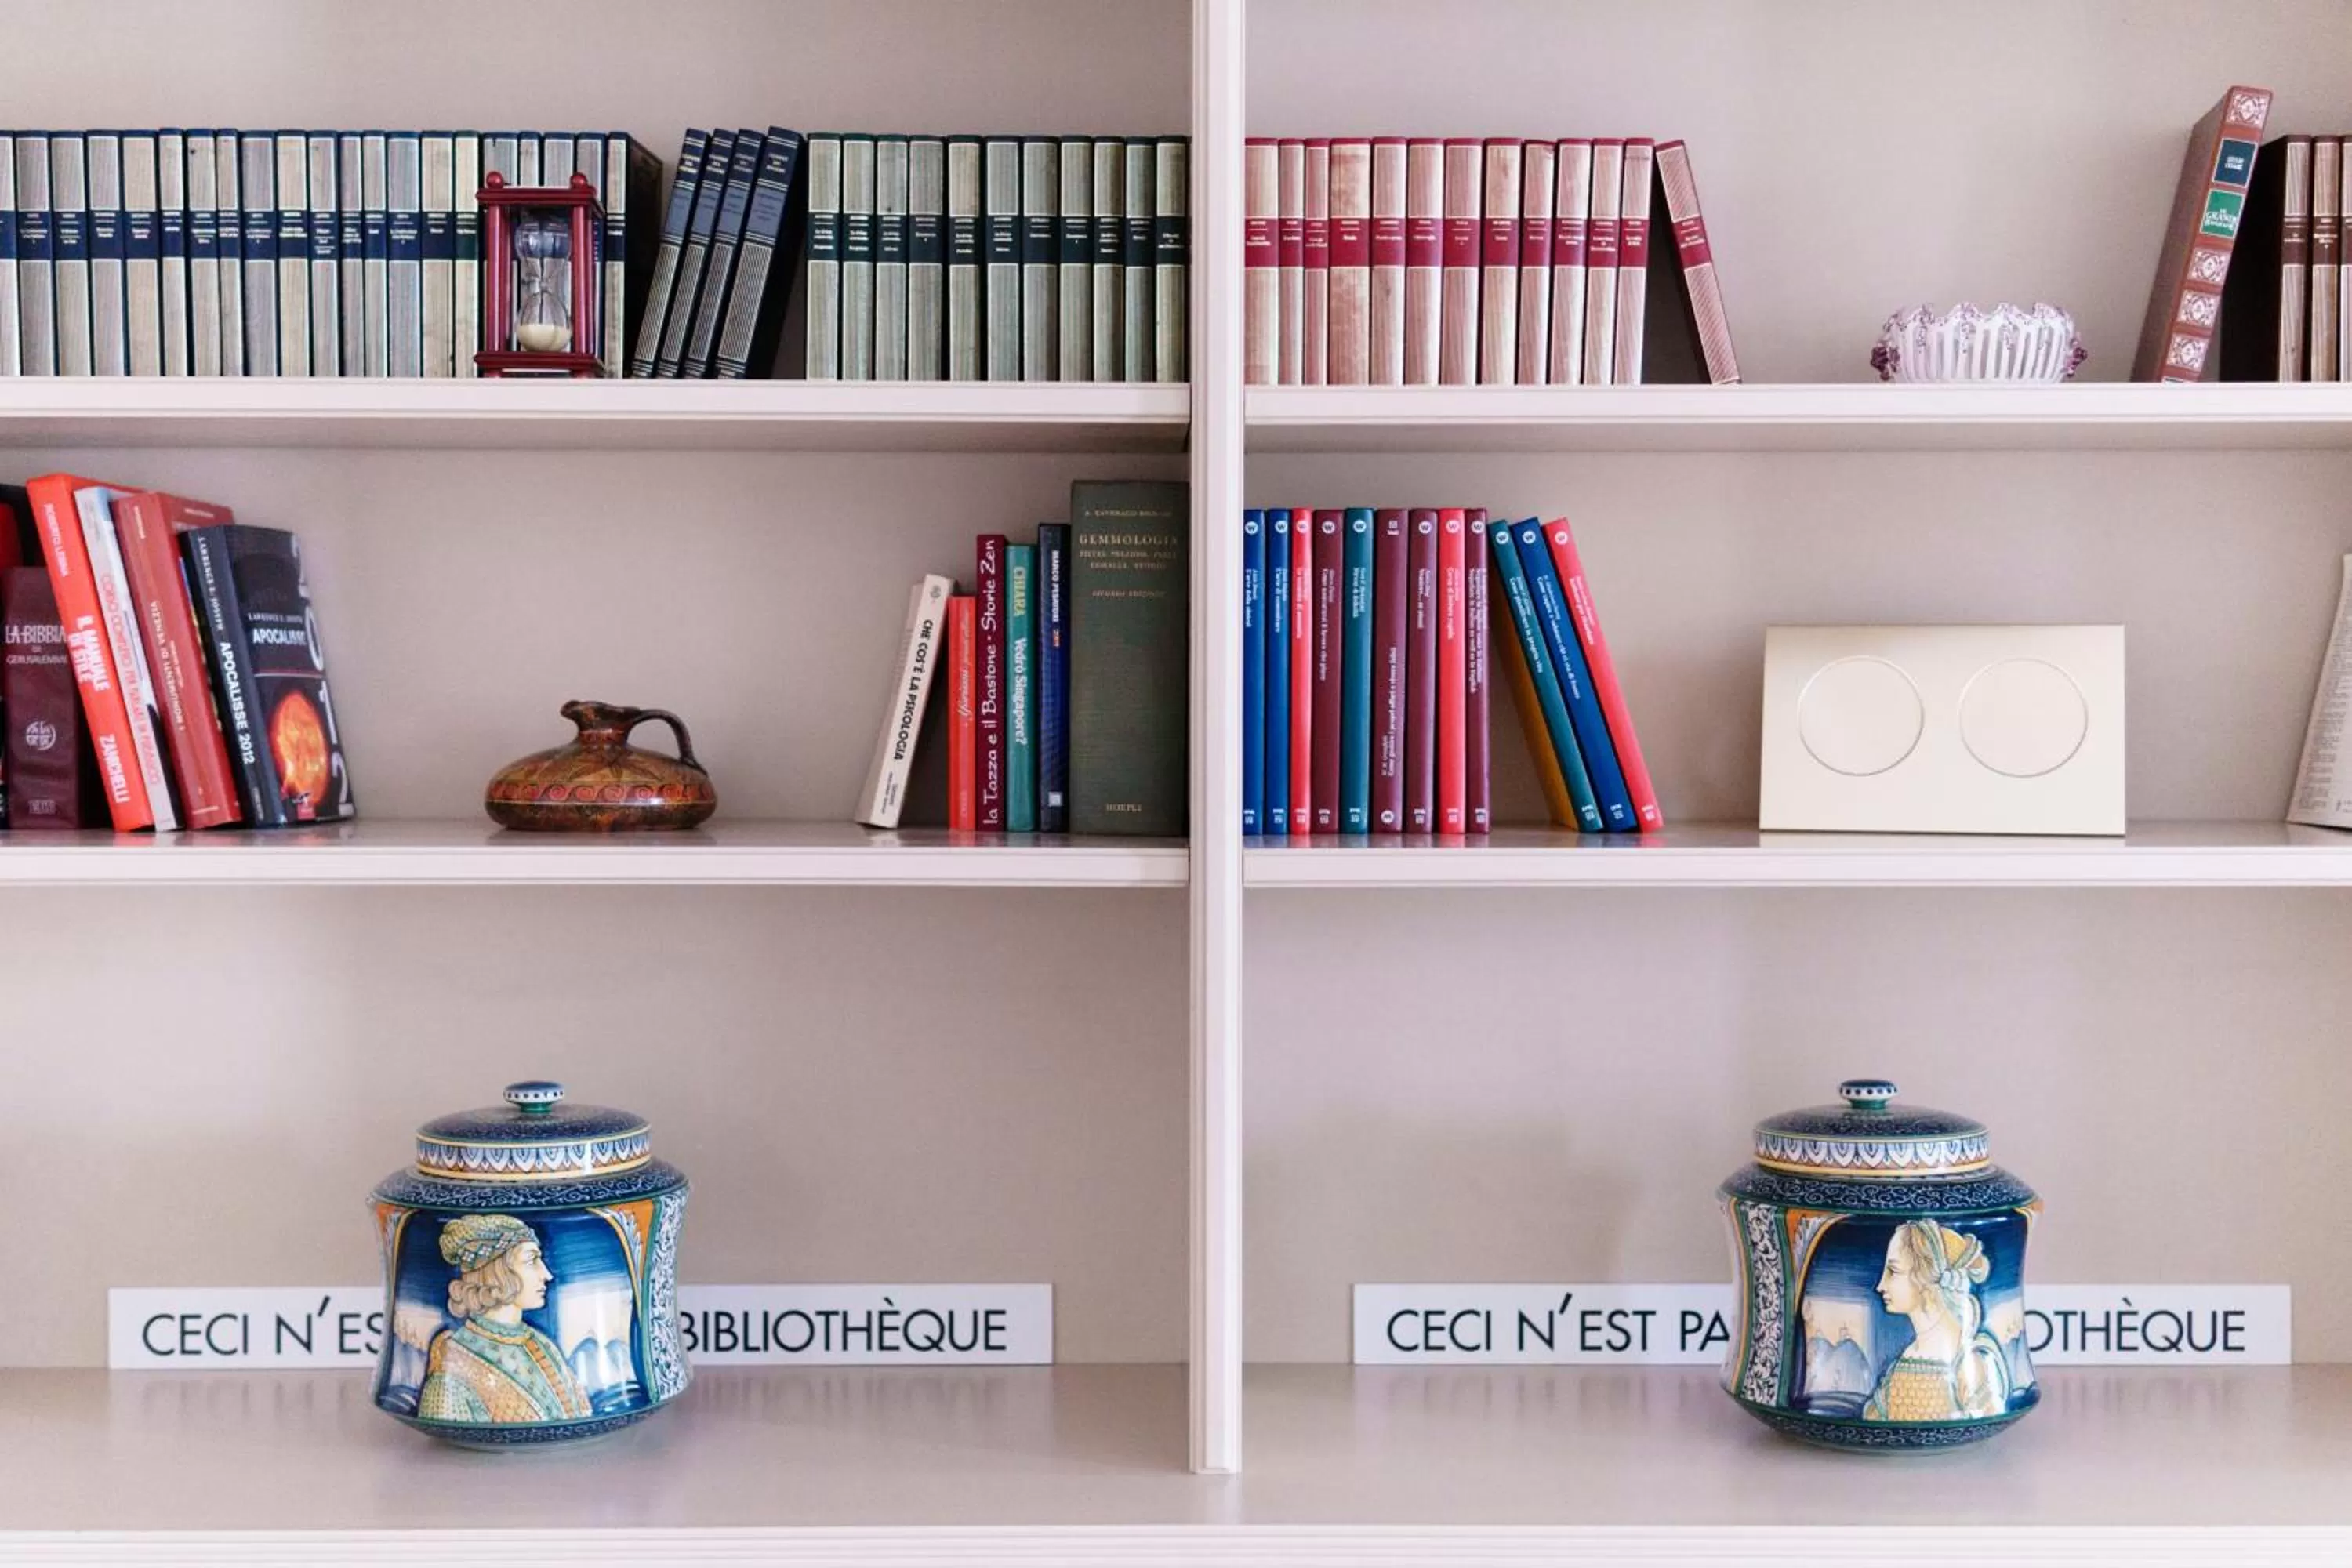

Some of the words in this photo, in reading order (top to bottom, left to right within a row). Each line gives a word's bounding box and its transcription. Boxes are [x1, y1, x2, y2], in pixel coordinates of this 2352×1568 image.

[982, 539, 995, 573] Zen
[1079, 534, 1177, 545] GEMMOLOGIA
[1051, 550, 1060, 583] MARCO
[982, 582, 996, 632] Storie
[1014, 567, 1026, 617] CHIARA
[5, 625, 20, 644] LA
[24, 625, 67, 644] BIBBIA
[75, 615, 95, 628] IL
[148, 599, 167, 644] VENEZIA
[253, 628, 307, 646] APOCALISSE
[920, 619, 934, 641] CHE
[67, 632, 83, 647] DI
[159, 645, 170, 658] DI
[1016, 637, 1028, 673] Vedrò
[72, 648, 93, 683] STILE
[78, 629, 110, 691] MANUALE
[912, 641, 931, 674] COS'È
[162, 660, 185, 724] MONUMENTI
[909, 676, 920, 691] LA
[982, 644, 997, 714] Bastone
[217, 640, 249, 731] APOCALISSE
[237, 731, 256, 765] 2012
[1014, 673, 1028, 744] Singapore?
[893, 693, 917, 760] PSICOLOGIA
[982, 717, 998, 728] il
[988, 732, 997, 745] e
[97, 734, 130, 803] ZANICHELLI
[983, 749, 998, 801] Tazza
[983, 807, 998, 825] la
[1105, 803, 1142, 813] HOEPLI
[142, 1312, 249, 1356] CECI
[276, 1295, 383, 1356] N'ES
[1387, 1309, 1491, 1353] CECI
[1518, 1294, 1656, 1353] N'EST
[1680, 1310, 1730, 1353] PA
[2026, 1295, 2245, 1353] OTHÈQUE
